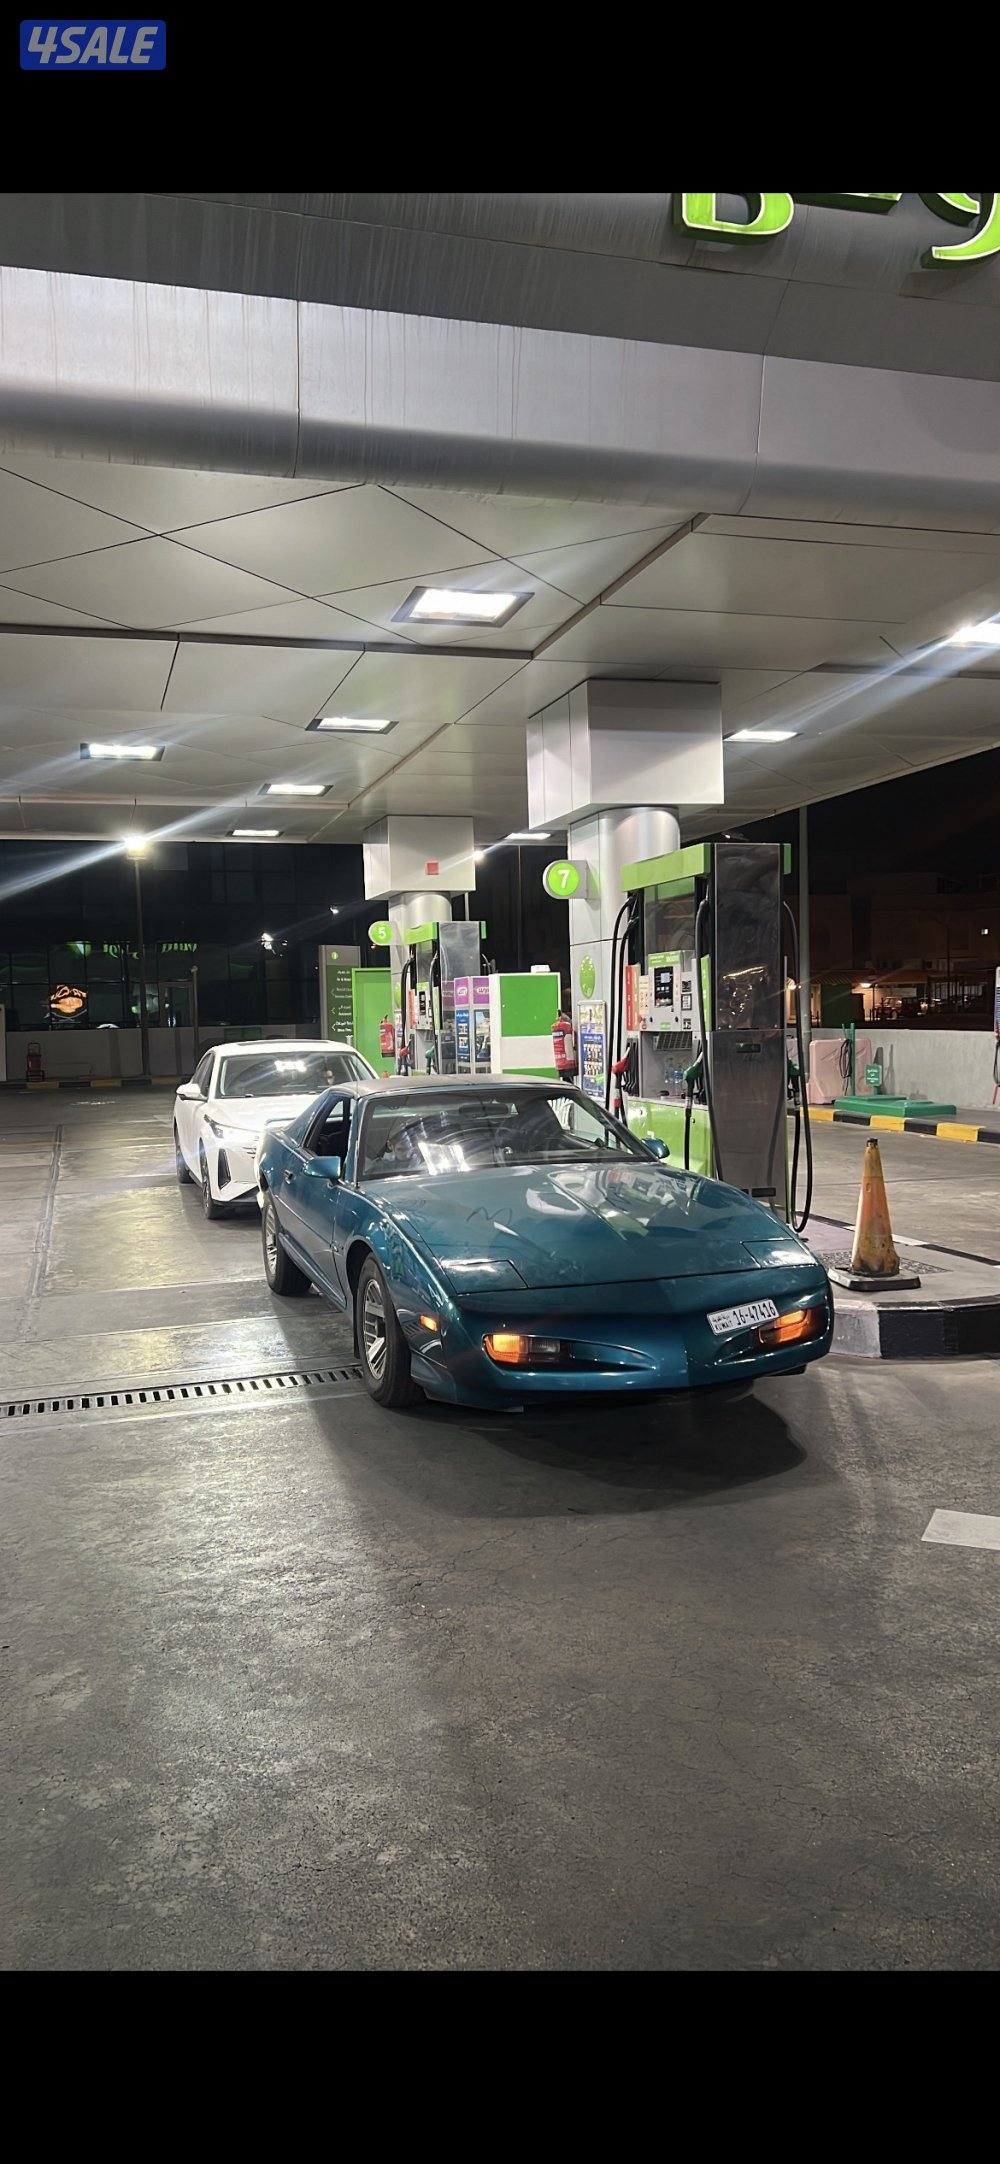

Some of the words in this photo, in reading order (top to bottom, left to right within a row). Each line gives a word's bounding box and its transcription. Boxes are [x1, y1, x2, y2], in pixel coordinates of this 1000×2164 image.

[557, 869, 571, 889] 7
[378, 926, 387, 939] 5
[732, 1302, 776, 1325] 16-47416
